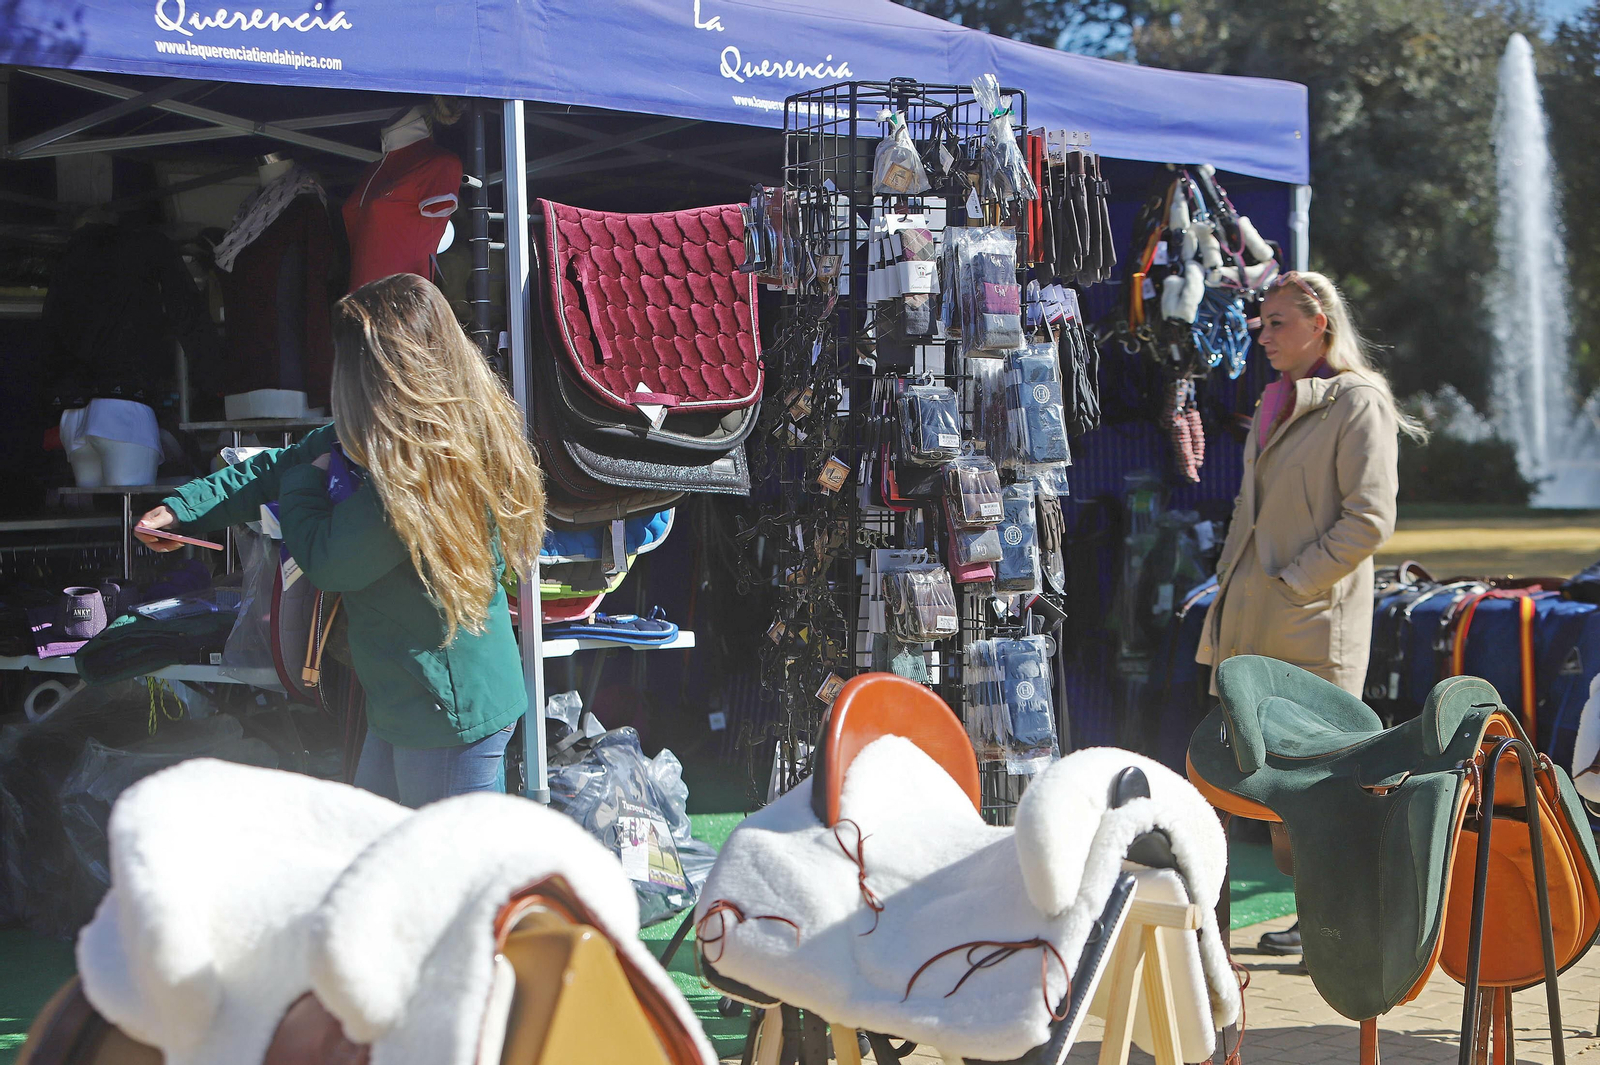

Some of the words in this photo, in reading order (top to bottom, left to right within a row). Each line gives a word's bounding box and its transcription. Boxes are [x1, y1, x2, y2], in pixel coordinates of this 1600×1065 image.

[154, 0, 353, 37] Querencia
[694, 0, 725, 32] La
[154, 39, 343, 71] www.laquerenciatiendahipica.com
[719, 45, 853, 83] Querencia
